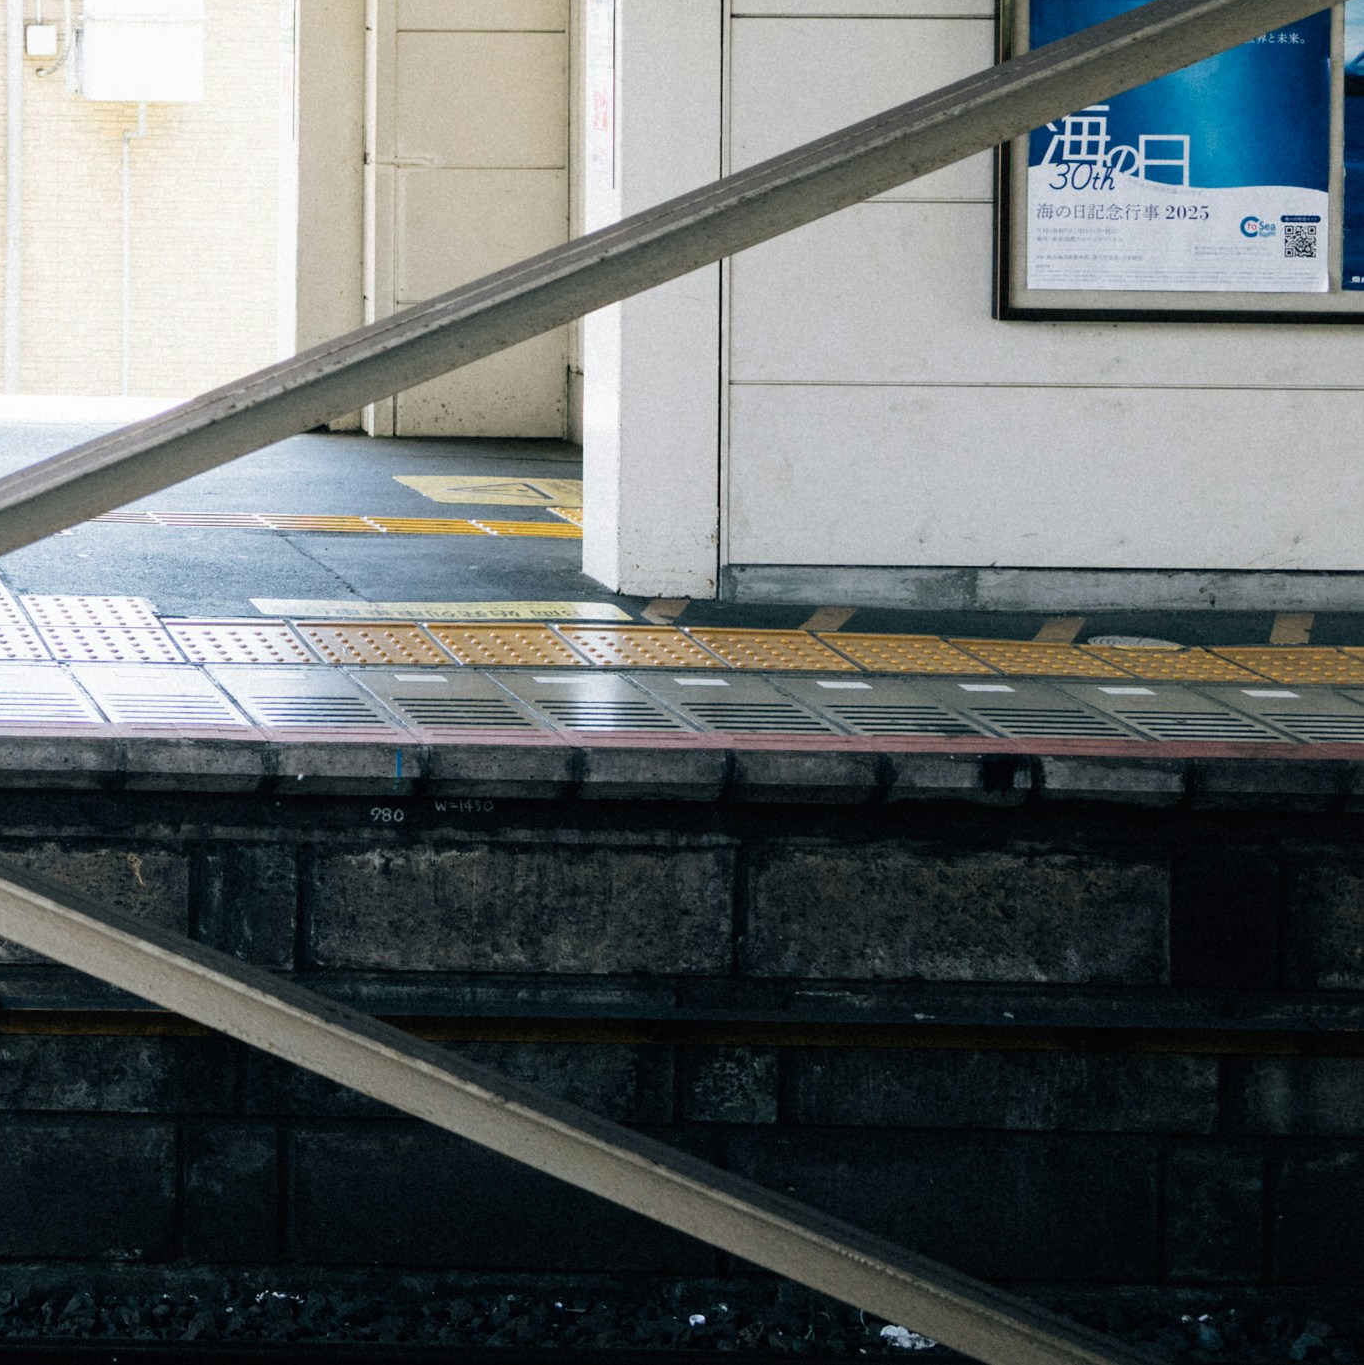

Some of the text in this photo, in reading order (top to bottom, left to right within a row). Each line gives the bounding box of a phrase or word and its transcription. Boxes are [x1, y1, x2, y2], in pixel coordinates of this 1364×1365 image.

[1048, 162, 1116, 191] 30th
[1036, 203, 1210, 222] 海の日記念行事 2025
[1258, 221, 1277, 232] Sea
[370, 799, 495, 823] 980 W=1450
